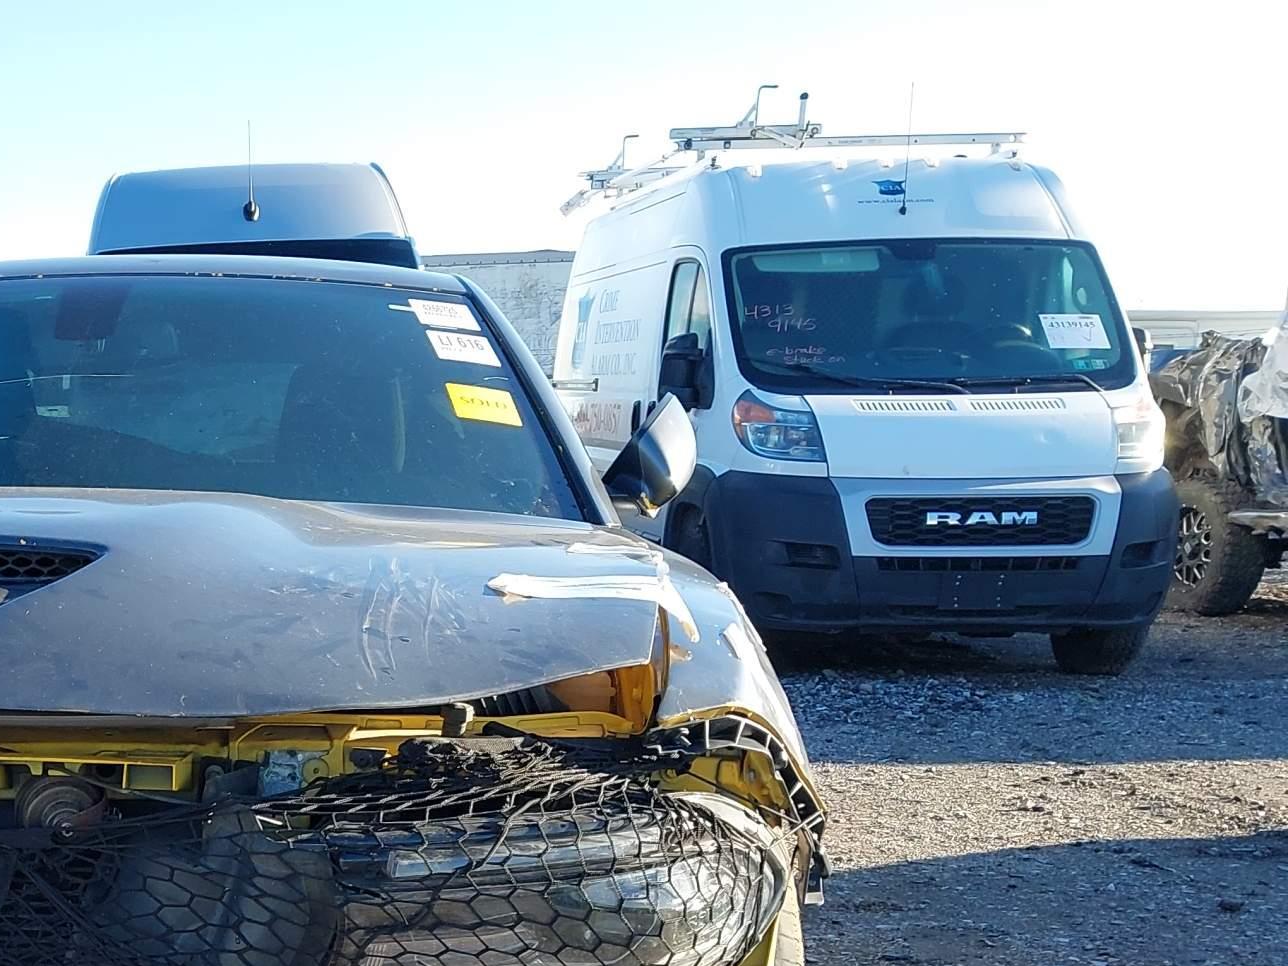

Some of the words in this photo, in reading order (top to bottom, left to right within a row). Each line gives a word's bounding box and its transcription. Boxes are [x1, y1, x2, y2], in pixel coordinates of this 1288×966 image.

[744, 304, 794, 320] 4313
[1048, 321, 1096, 329] 43139145
[456, 337, 485, 351] 616
[926, 511, 1038, 526] RAM
